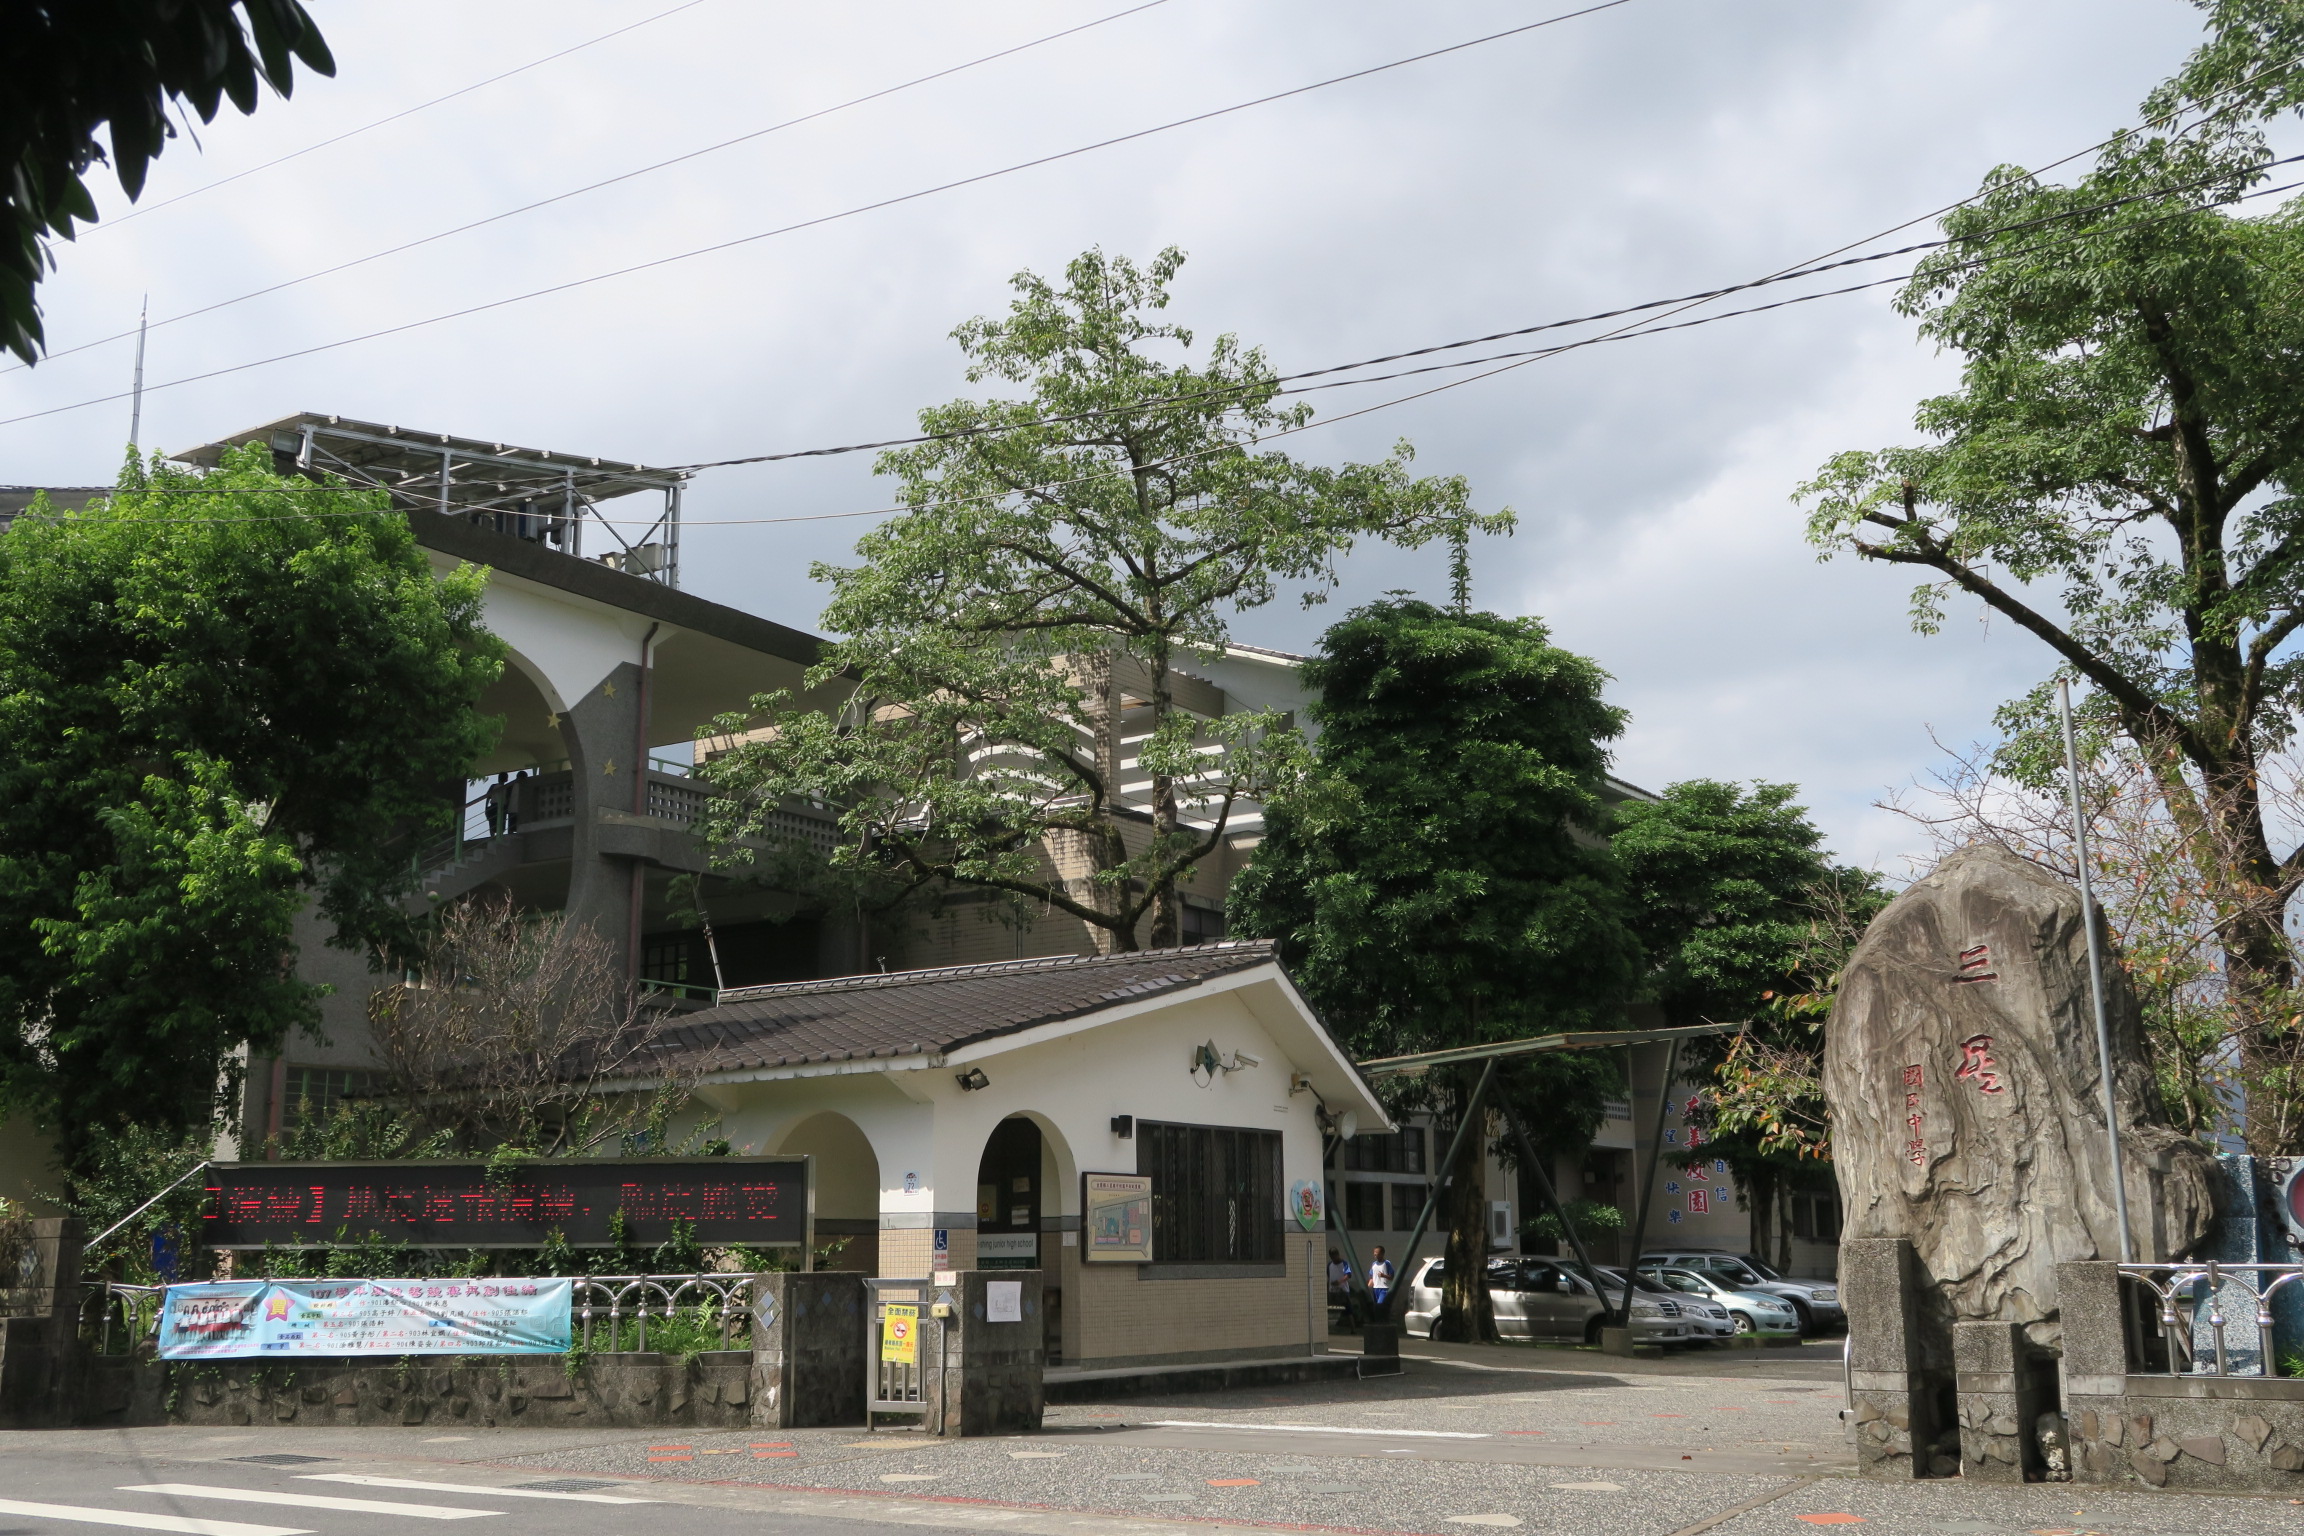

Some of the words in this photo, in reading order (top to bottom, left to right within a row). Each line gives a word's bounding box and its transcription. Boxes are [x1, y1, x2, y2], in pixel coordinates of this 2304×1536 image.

[1952, 944, 2005, 1095] 三星
[1902, 1064, 1929, 1166] 國民中學
[907, 1182, 915, 1190] 72
[1714, 1160, 1728, 1202] 自信
[993, 1239, 1006, 1250] junior
[1006, 1238, 1017, 1250] high
[1017, 1238, 1034, 1248] school
[270, 1299, 287, 1315] 賀
